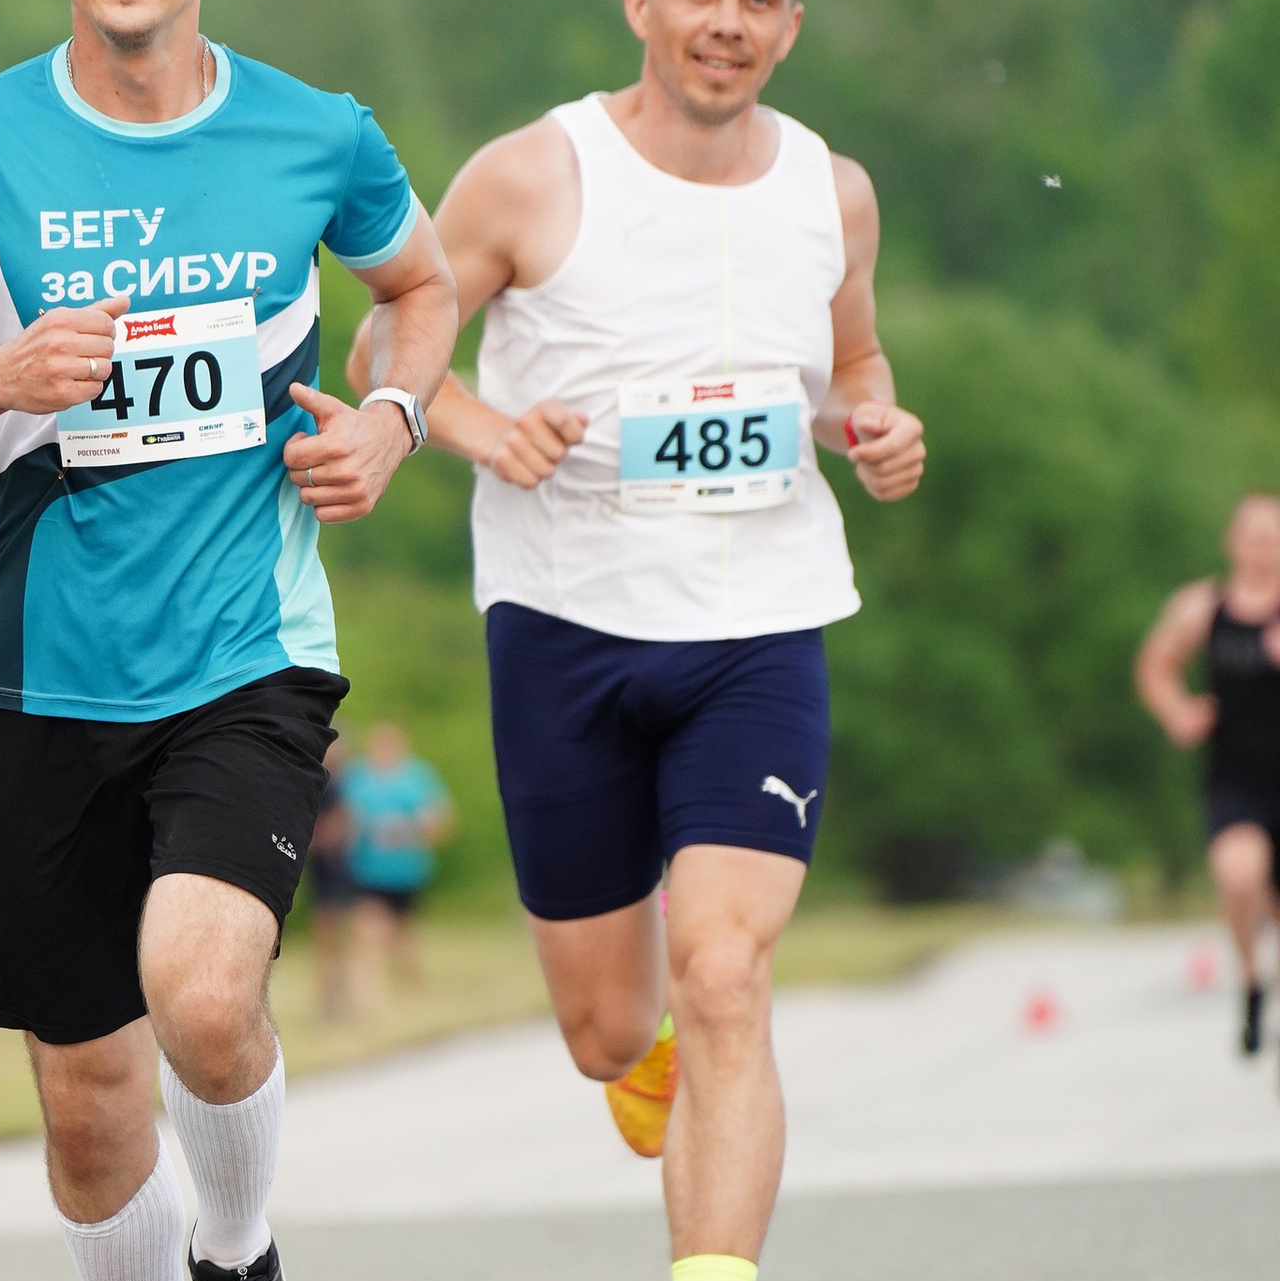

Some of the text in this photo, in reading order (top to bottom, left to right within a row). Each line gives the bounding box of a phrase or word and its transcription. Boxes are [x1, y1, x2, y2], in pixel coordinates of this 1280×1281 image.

[40, 207, 165, 250] БЕГУ
[41, 251, 278, 303] за СИБУР
[90, 350, 223, 420] 470
[77, 448, 121, 457] РОСГОССТРАХ
[655, 414, 771, 471] 485
